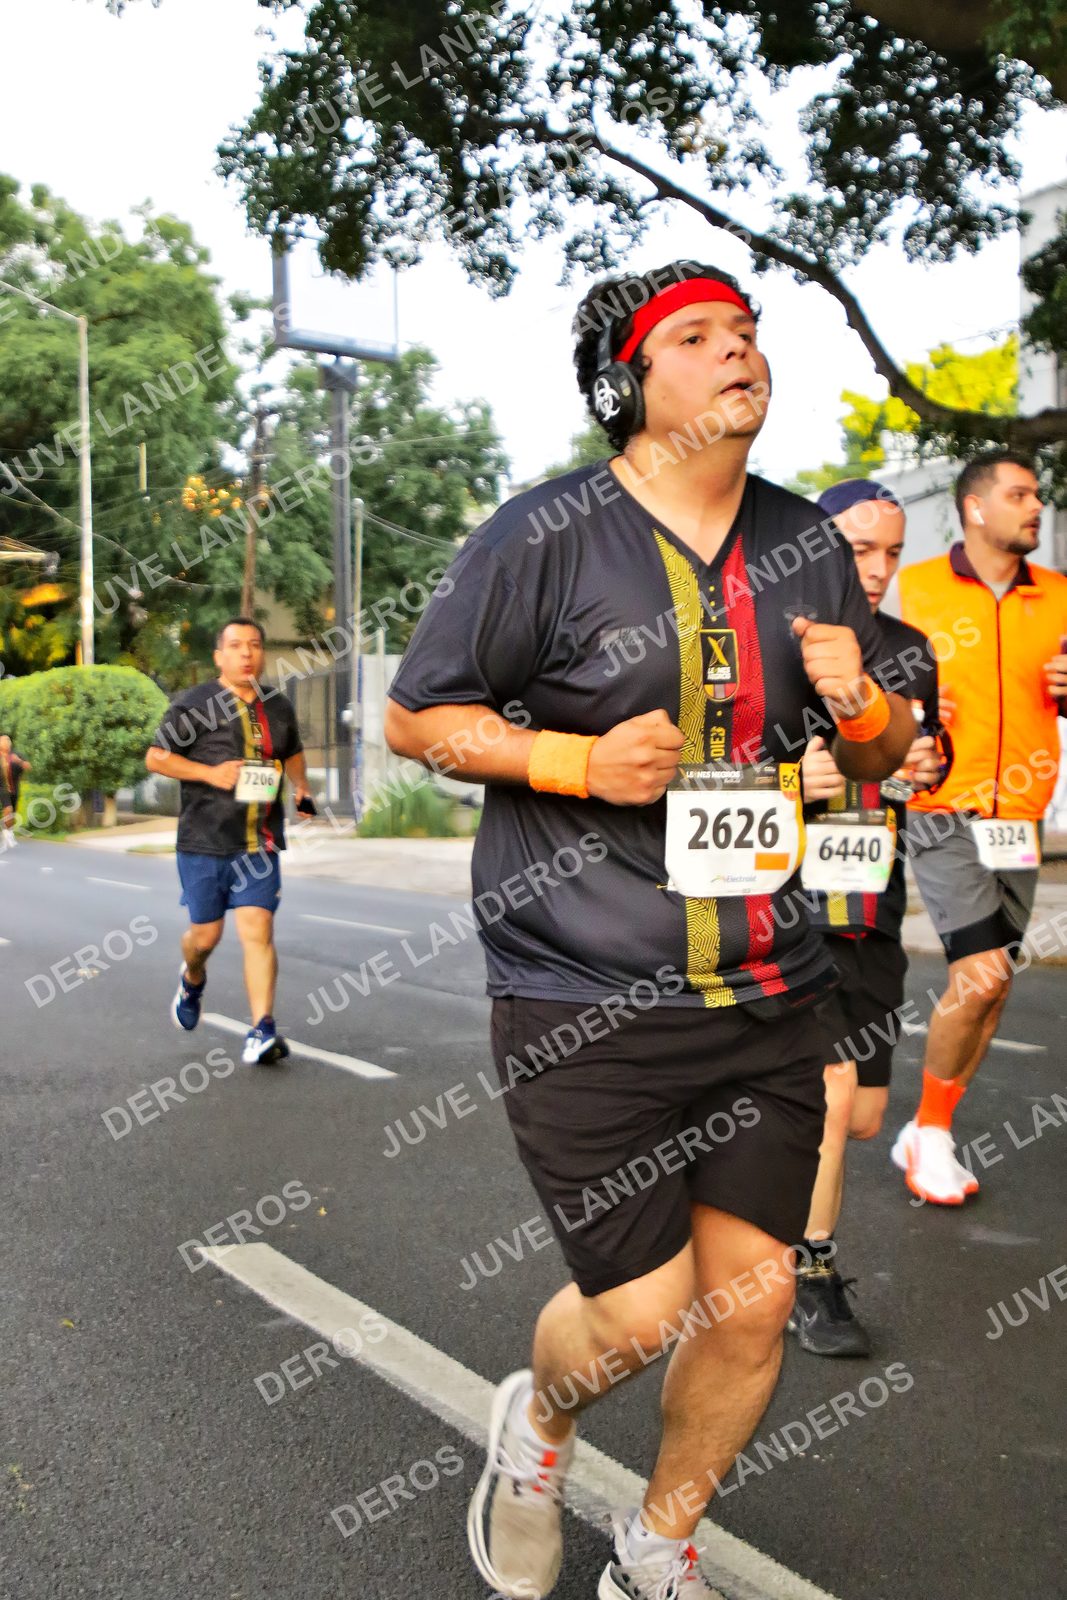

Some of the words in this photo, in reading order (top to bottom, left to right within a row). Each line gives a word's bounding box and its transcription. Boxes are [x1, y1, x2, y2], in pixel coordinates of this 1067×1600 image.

[245, 771, 274, 786] 7206
[688, 807, 779, 850] 2626
[985, 825, 1026, 846] 3324
[819, 836, 881, 862] 6440
